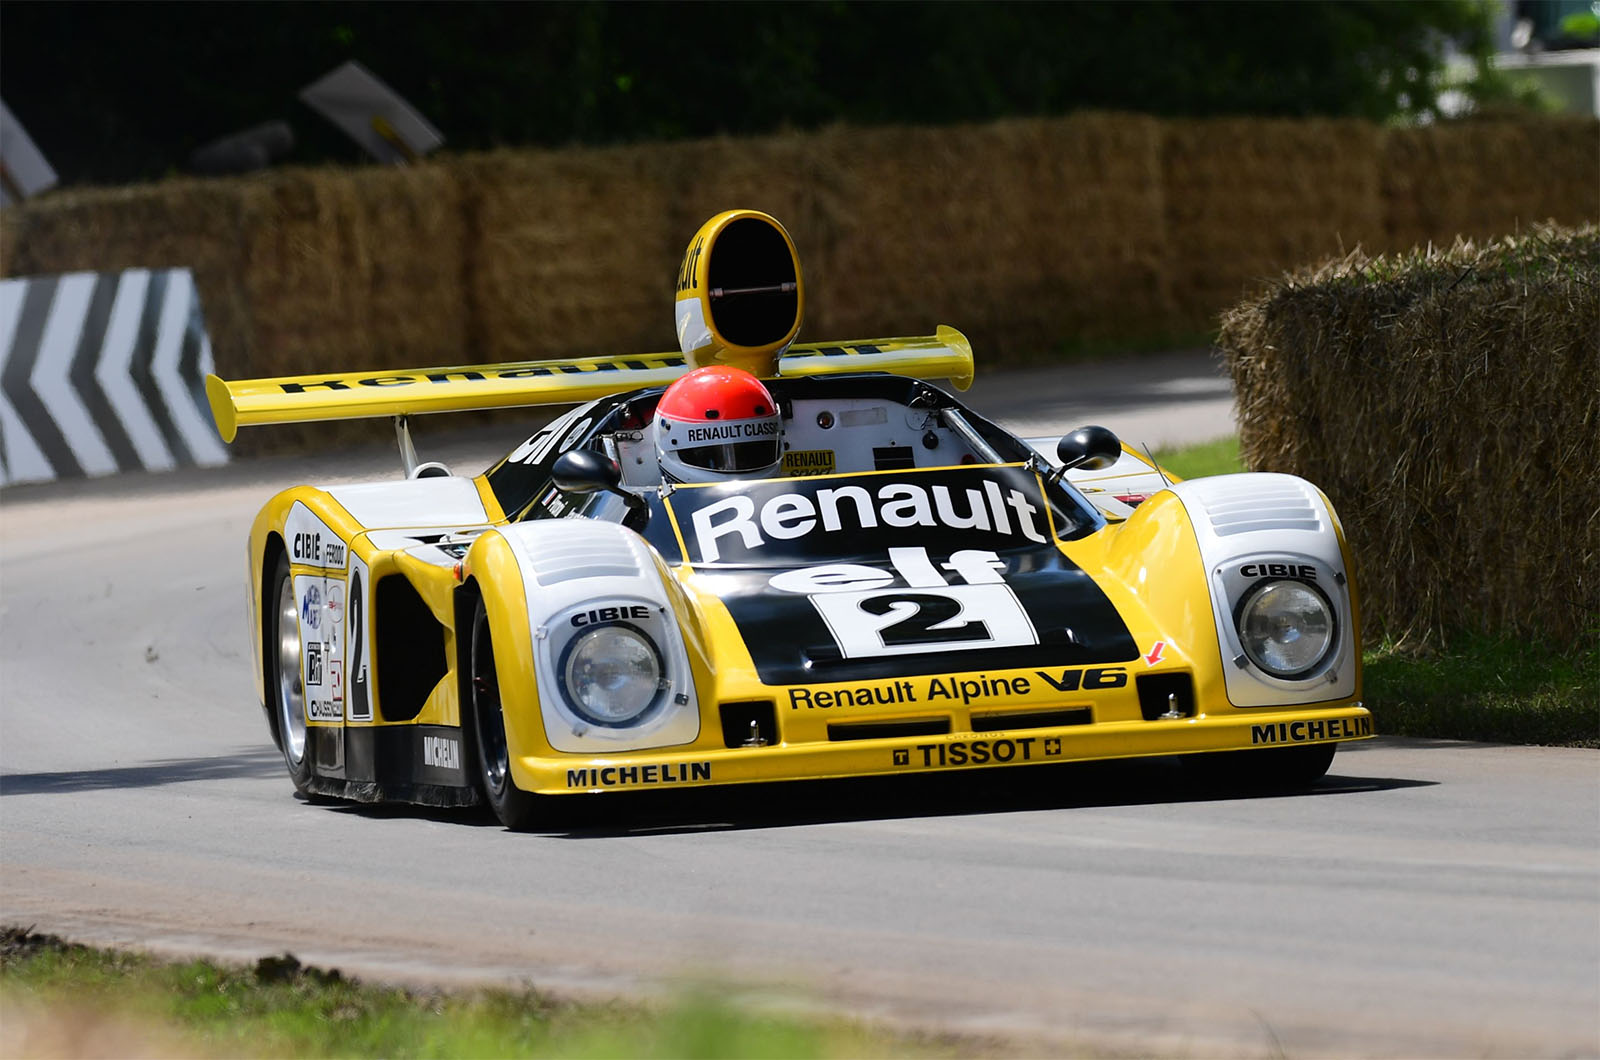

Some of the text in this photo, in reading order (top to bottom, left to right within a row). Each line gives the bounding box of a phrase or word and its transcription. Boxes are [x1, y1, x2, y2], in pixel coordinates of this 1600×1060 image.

[688, 425, 742, 441] RENAULT
[786, 451, 832, 467] RENAULT
[692, 480, 1047, 564] Renault
[768, 547, 1007, 594] elf
[857, 594, 994, 648] 2
[350, 567, 371, 719] 2
[788, 667, 1127, 709] Renault Alpine V6
[1251, 716, 1370, 744] MICHELIN
[424, 736, 460, 769] MICHELIN
[917, 738, 1036, 766] TISSOT
[566, 762, 711, 788] MICHELIN
